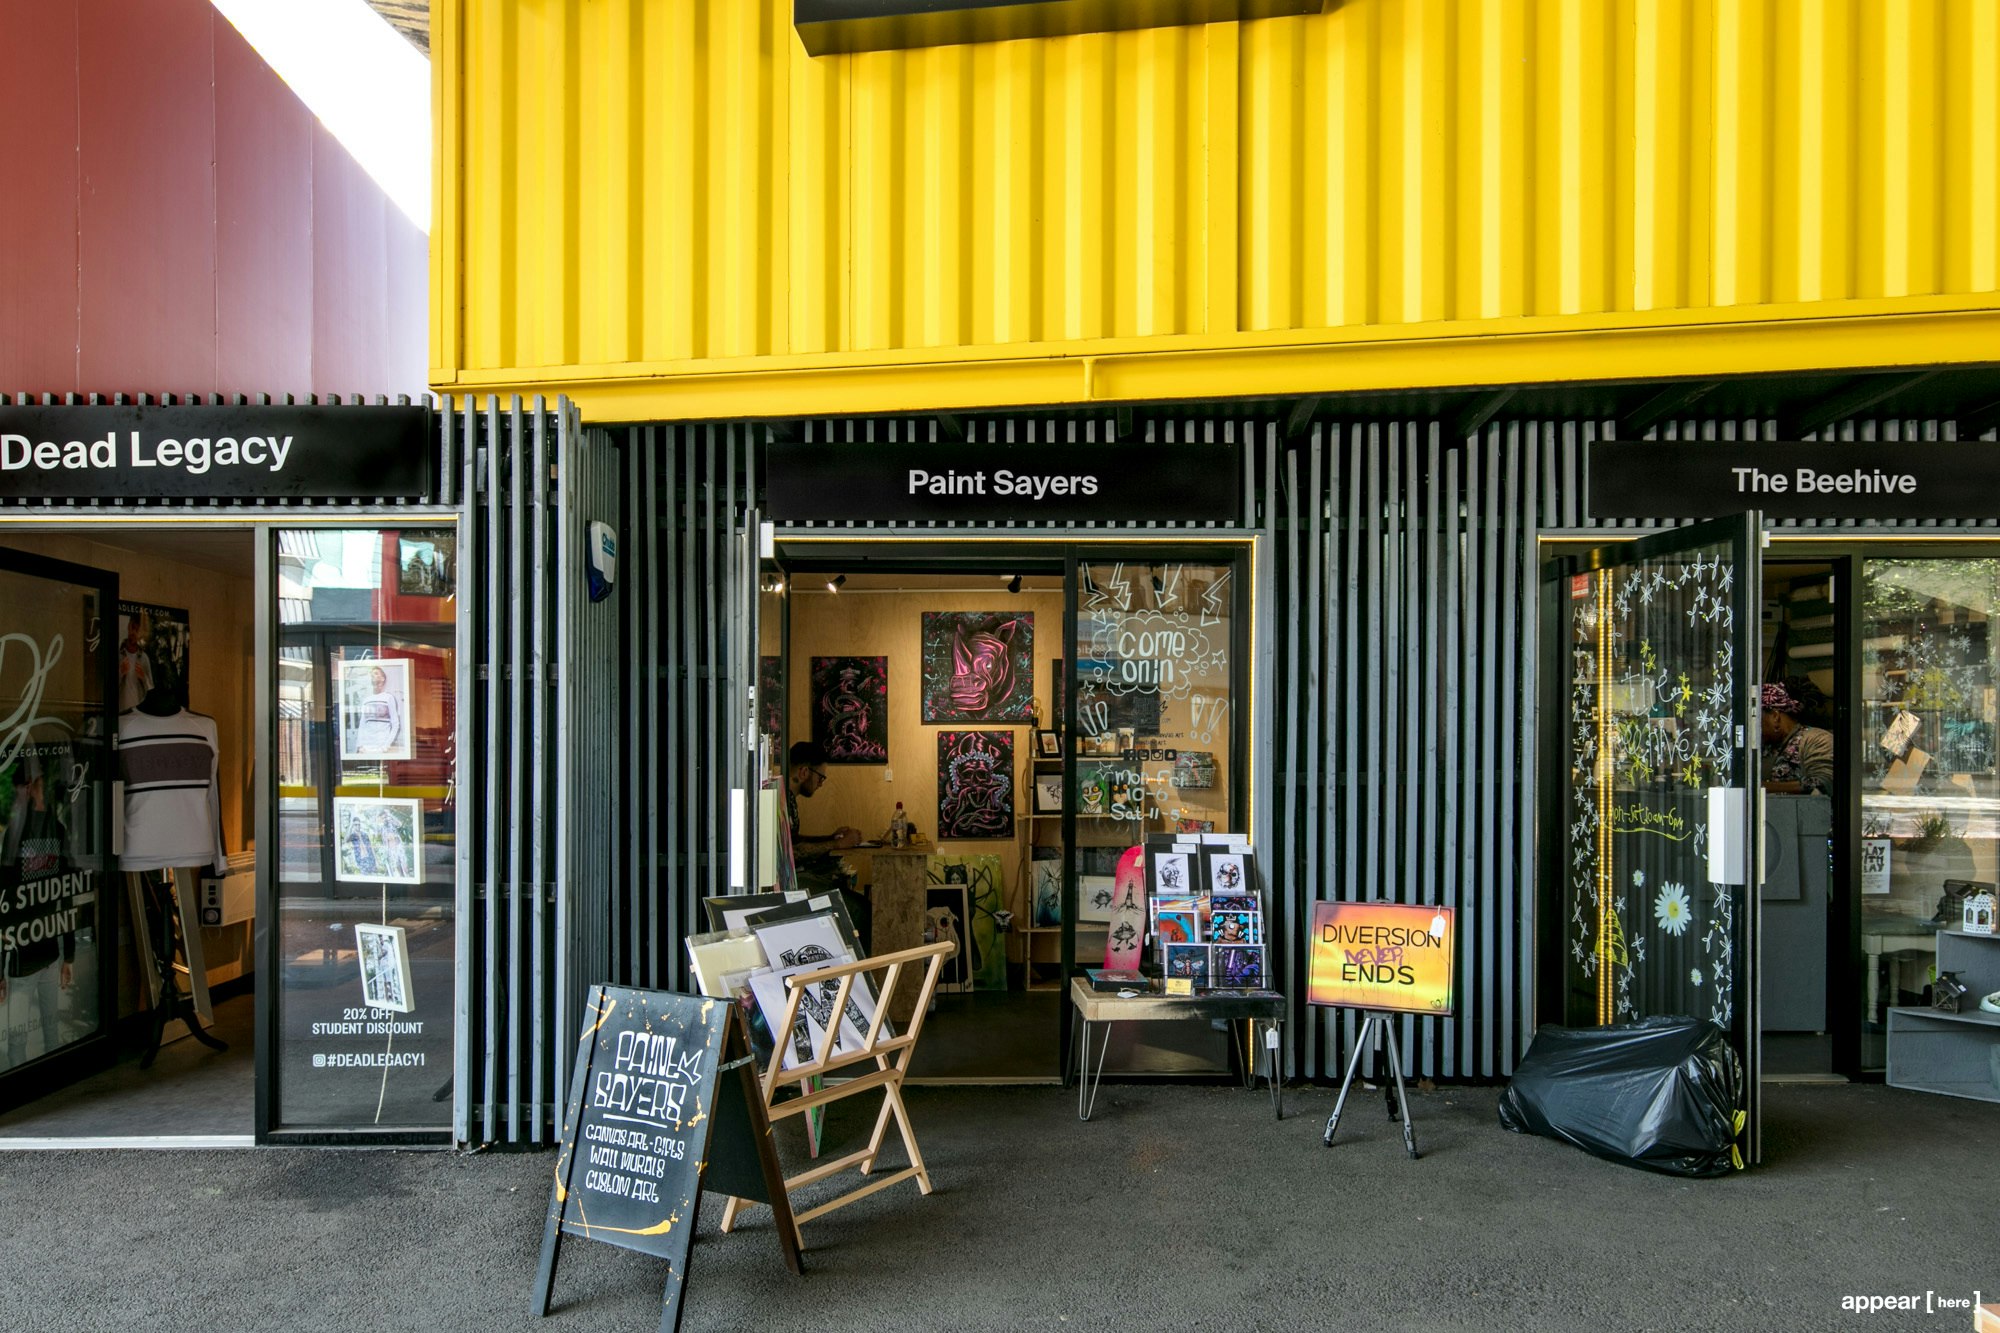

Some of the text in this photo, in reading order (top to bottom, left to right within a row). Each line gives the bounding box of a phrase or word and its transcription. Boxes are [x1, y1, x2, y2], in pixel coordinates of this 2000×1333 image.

[1, 431, 293, 474] Dead Legacy
[909, 470, 1098, 500] Paint Sayers
[1731, 467, 1917, 494] The Beehive
[1111, 803, 1145, 821] Sat
[16, 869, 93, 909] STUDENT
[1322, 924, 1441, 949] DIVERSION
[1344, 945, 1404, 967] NEVER
[1342, 963, 1415, 985] ENDS
[343, 1008, 391, 1020] 20% OFF
[312, 1022, 424, 1035] STUDENT DISCOUNT
[327, 1053, 425, 1067] #DEADLEGACY1
[594, 1071, 687, 1122] SAYERS
[585, 1124, 626, 1146] CANVAS
[620, 1152, 666, 1179] MURALS
[585, 1169, 631, 1197] CUSTOM
